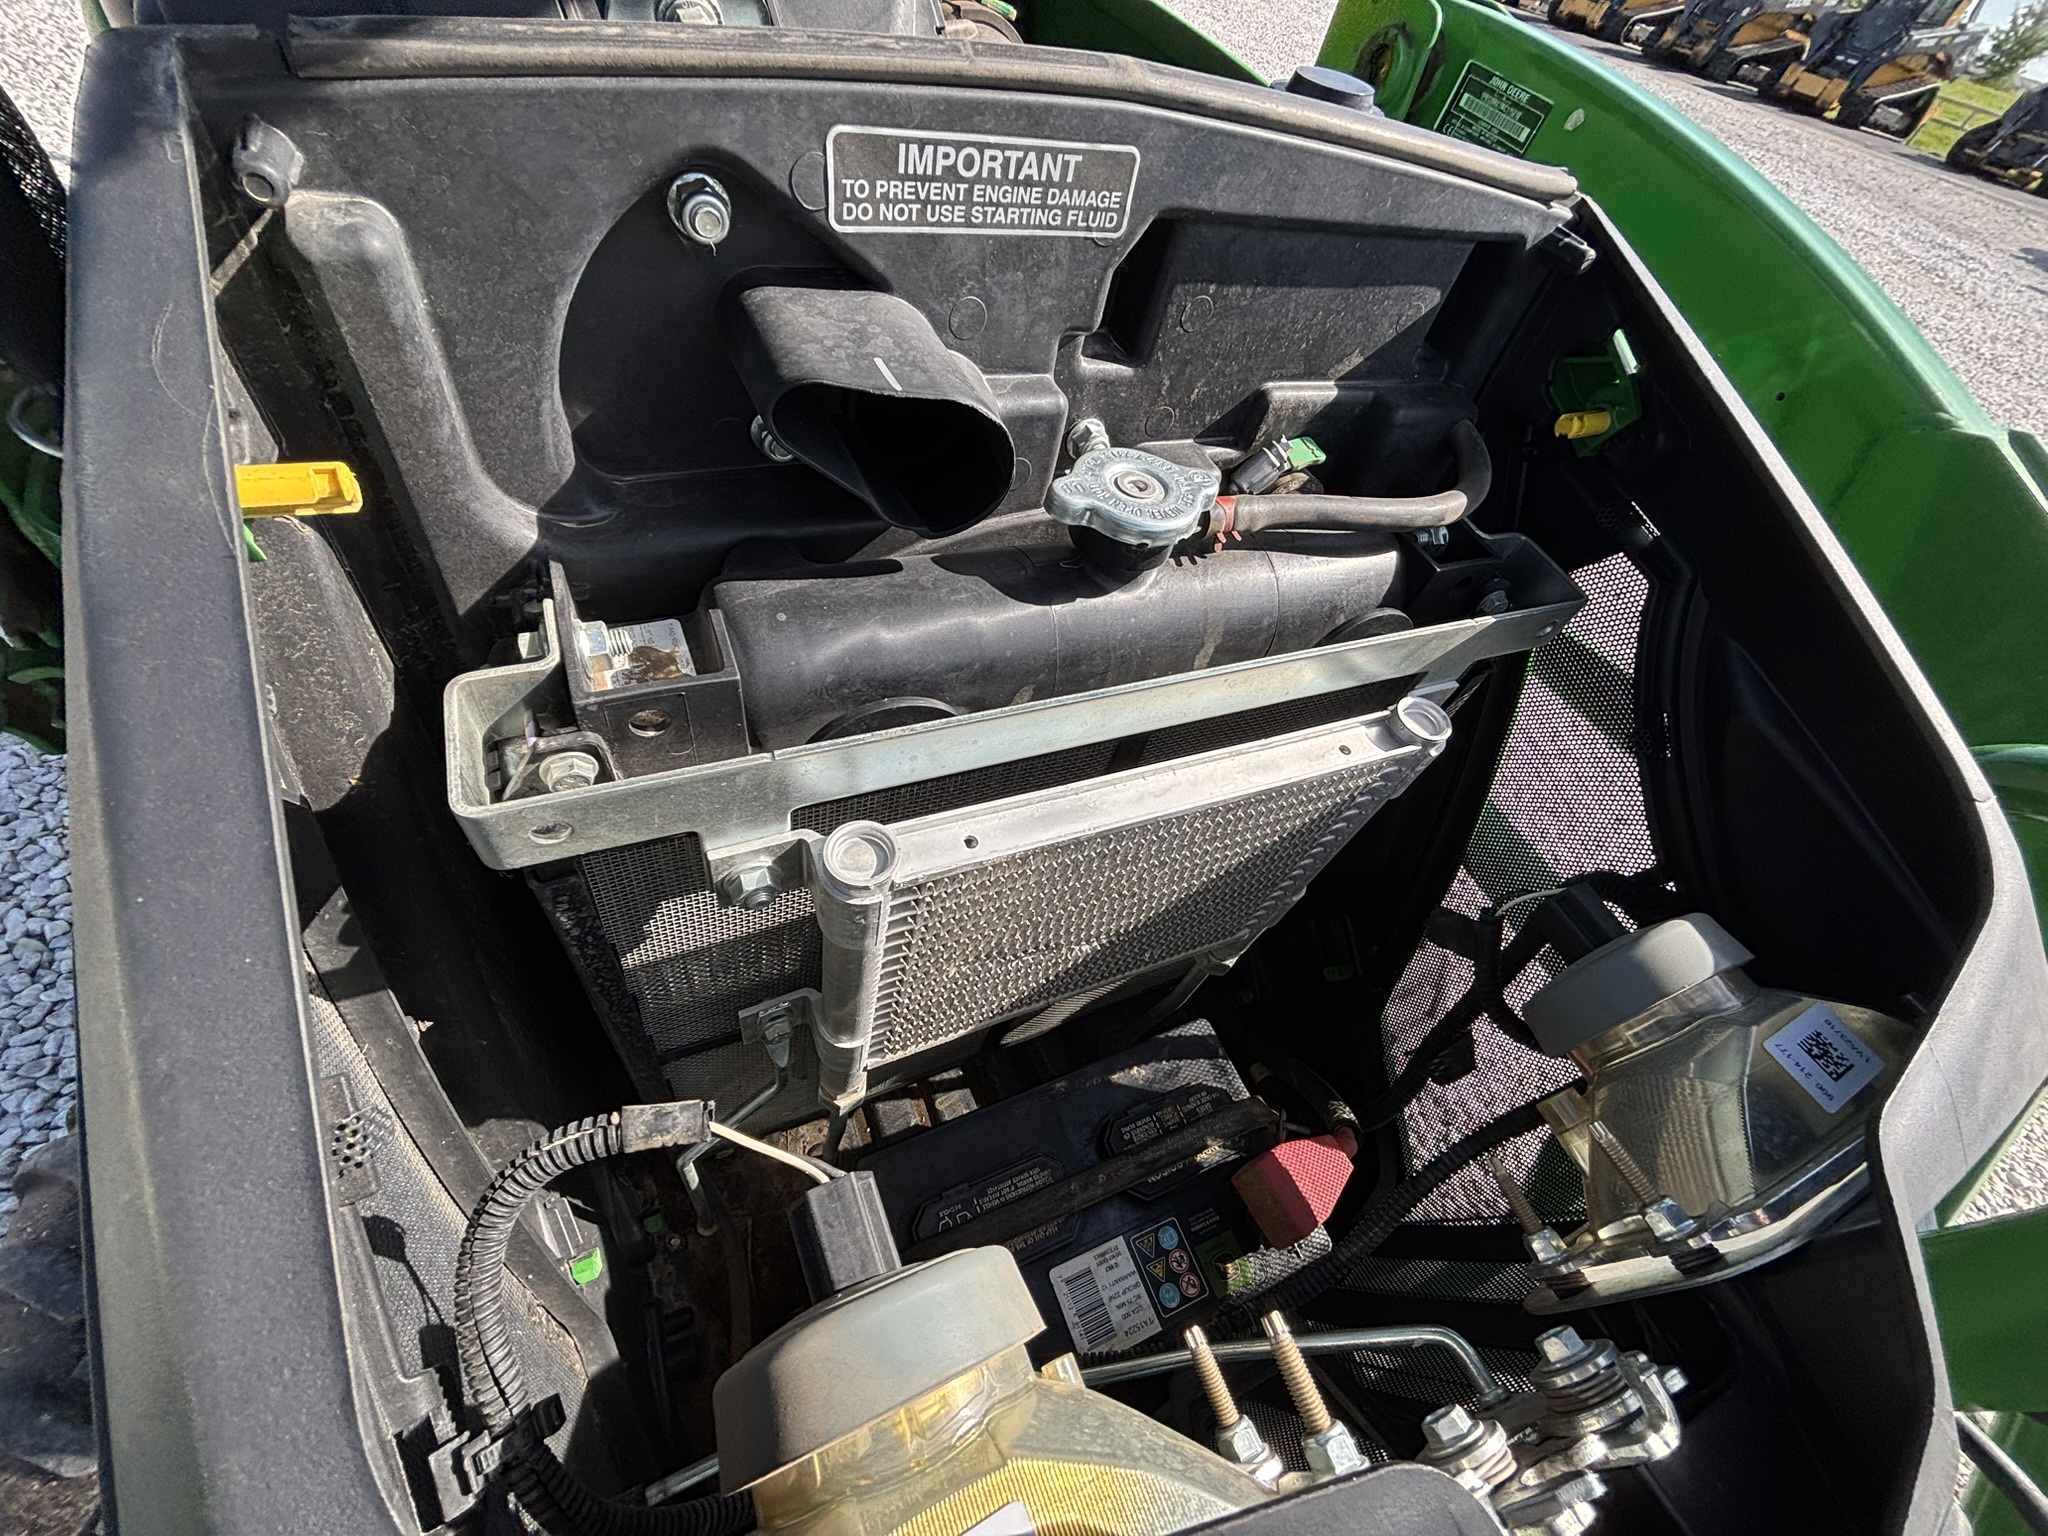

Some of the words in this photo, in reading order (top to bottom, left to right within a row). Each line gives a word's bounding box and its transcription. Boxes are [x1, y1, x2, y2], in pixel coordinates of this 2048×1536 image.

[1489, 76, 1509, 91] JOHN
[1507, 85, 1531, 103] DEERE
[898, 143, 1082, 183] IMPORTANT
[841, 179, 870, 198] TO
[875, 180, 968, 202] PREVENT
[972, 184, 1042, 205] ENGINE
[1048, 188, 1122, 209] DAMAGE
[842, 202, 873, 221] DO
[879, 203, 921, 223] NOT
[926, 205, 965, 223] USE
[970, 205, 1062, 226] STARTING
[1066, 209, 1118, 228] FLUID
[1109, 497, 1143, 518] OPEN
[1145, 503, 1185, 520] NEVER
[939, 1204, 962, 1217] RECYCLE
[1108, 1270, 1136, 1287] WARRANTY
[1121, 1281, 1141, 1296] GROUP
[1133, 1293, 1142, 1302] RC
[1121, 1311, 1132, 1321] 500
[1130, 1305, 1144, 1315] CCA
[1124, 1317, 1154, 1338] TA15224
